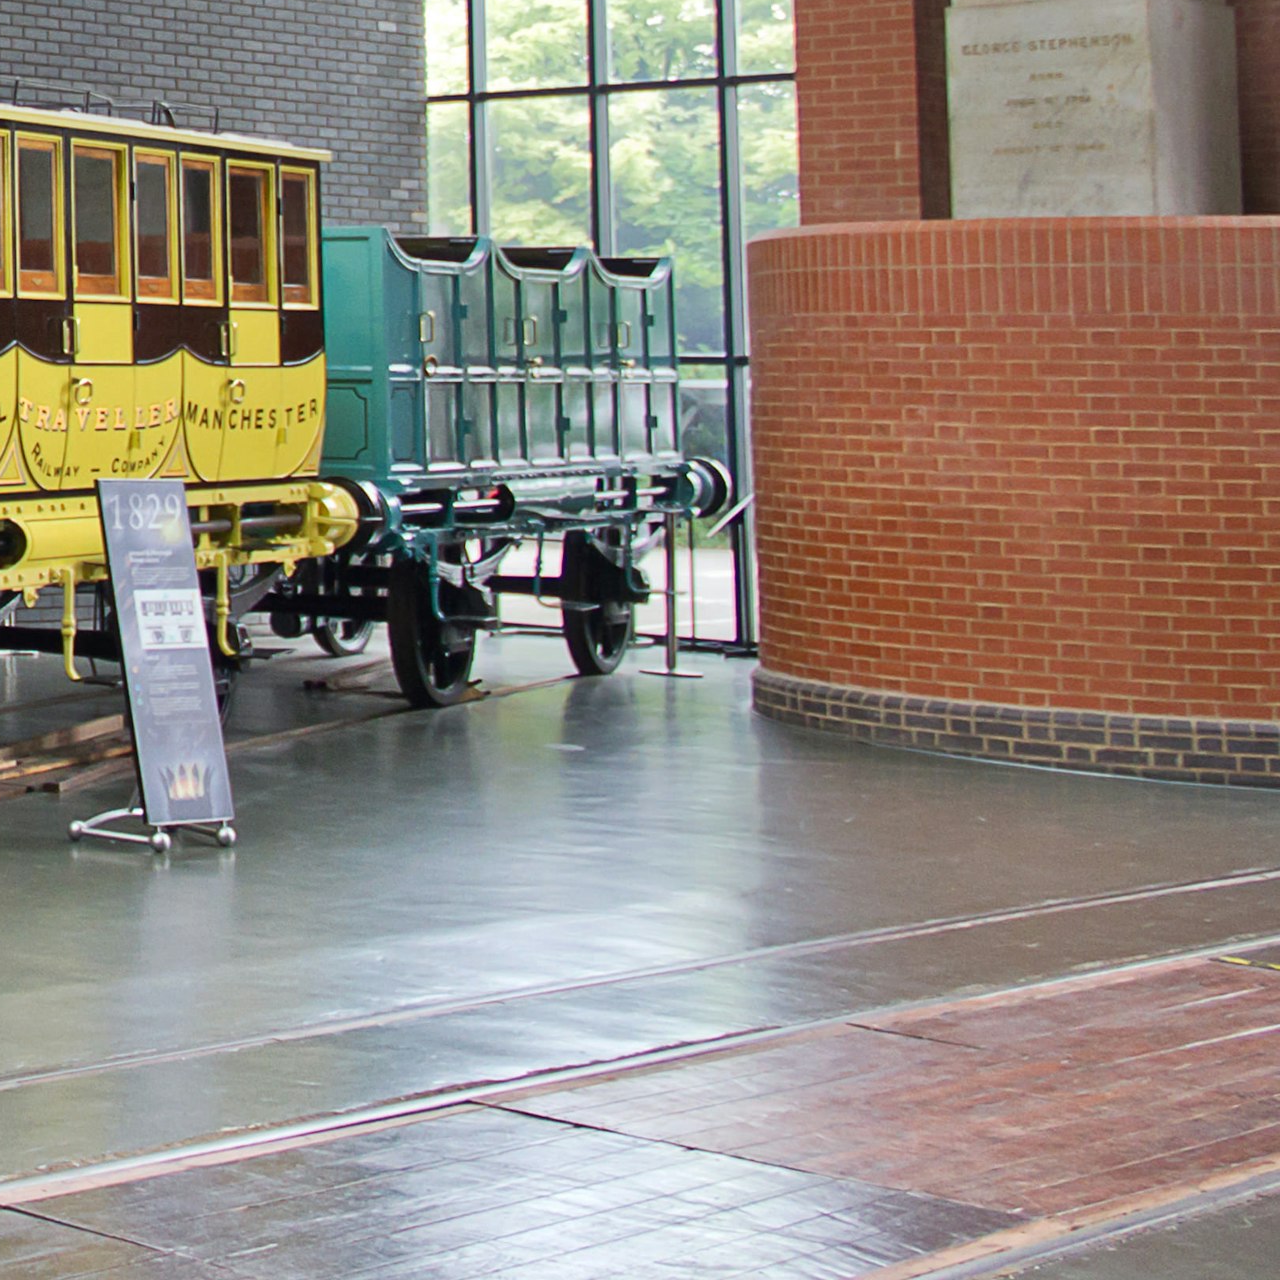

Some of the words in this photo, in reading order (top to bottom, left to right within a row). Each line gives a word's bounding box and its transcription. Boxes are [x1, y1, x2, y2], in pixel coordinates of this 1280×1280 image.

[19, 396, 180, 432] TRAVELLER
[186, 398, 318, 430] MANCHESTER
[108, 493, 181, 530] 1829
